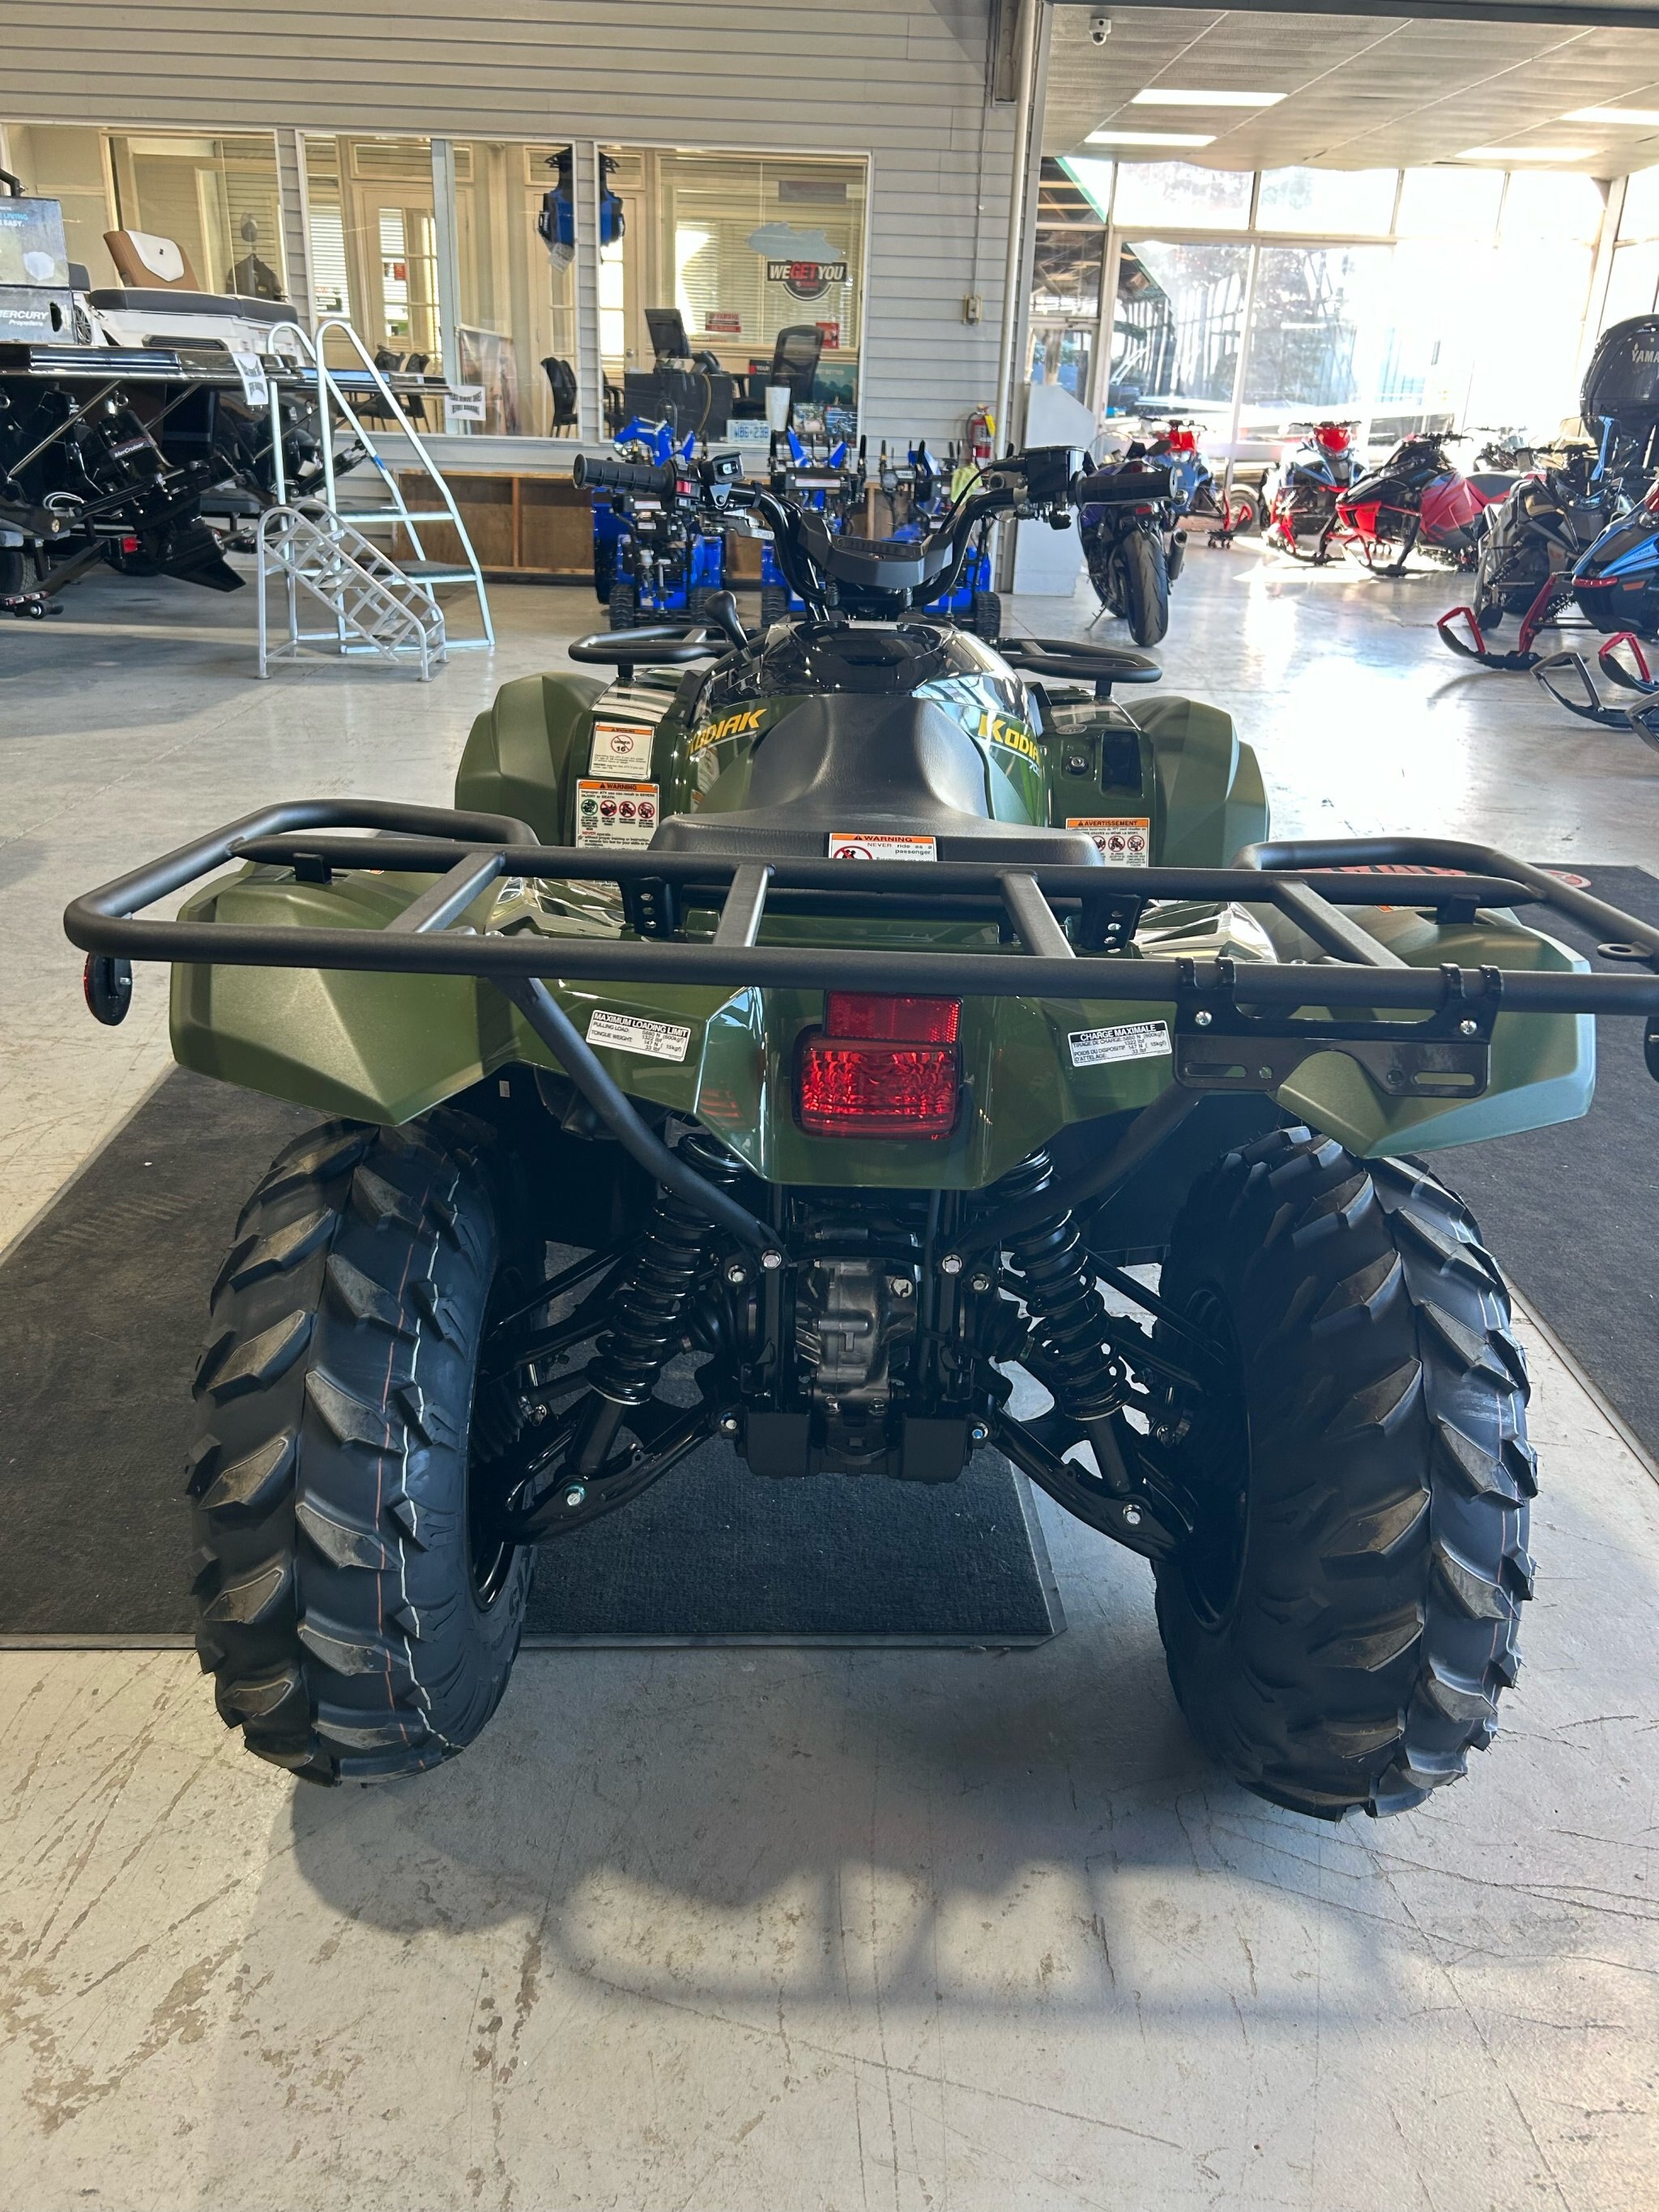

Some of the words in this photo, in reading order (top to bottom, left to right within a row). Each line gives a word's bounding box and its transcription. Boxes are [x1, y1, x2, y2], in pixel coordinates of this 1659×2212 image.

[4, 219, 24, 228] EASY.
[593, 1021, 614, 1030] PULLING
[594, 1012, 632, 1026] MAXIMUM
[632, 1020, 667, 1034] LOADING
[667, 1027, 688, 1038] LIMIT
[591, 1029, 612, 1038] TONGUE
[1080, 1029, 1114, 1042] CHARGE
[1114, 1024, 1157, 1037] MAXIMALE
[1098, 1045, 1125, 1053] DISPOSITIF
